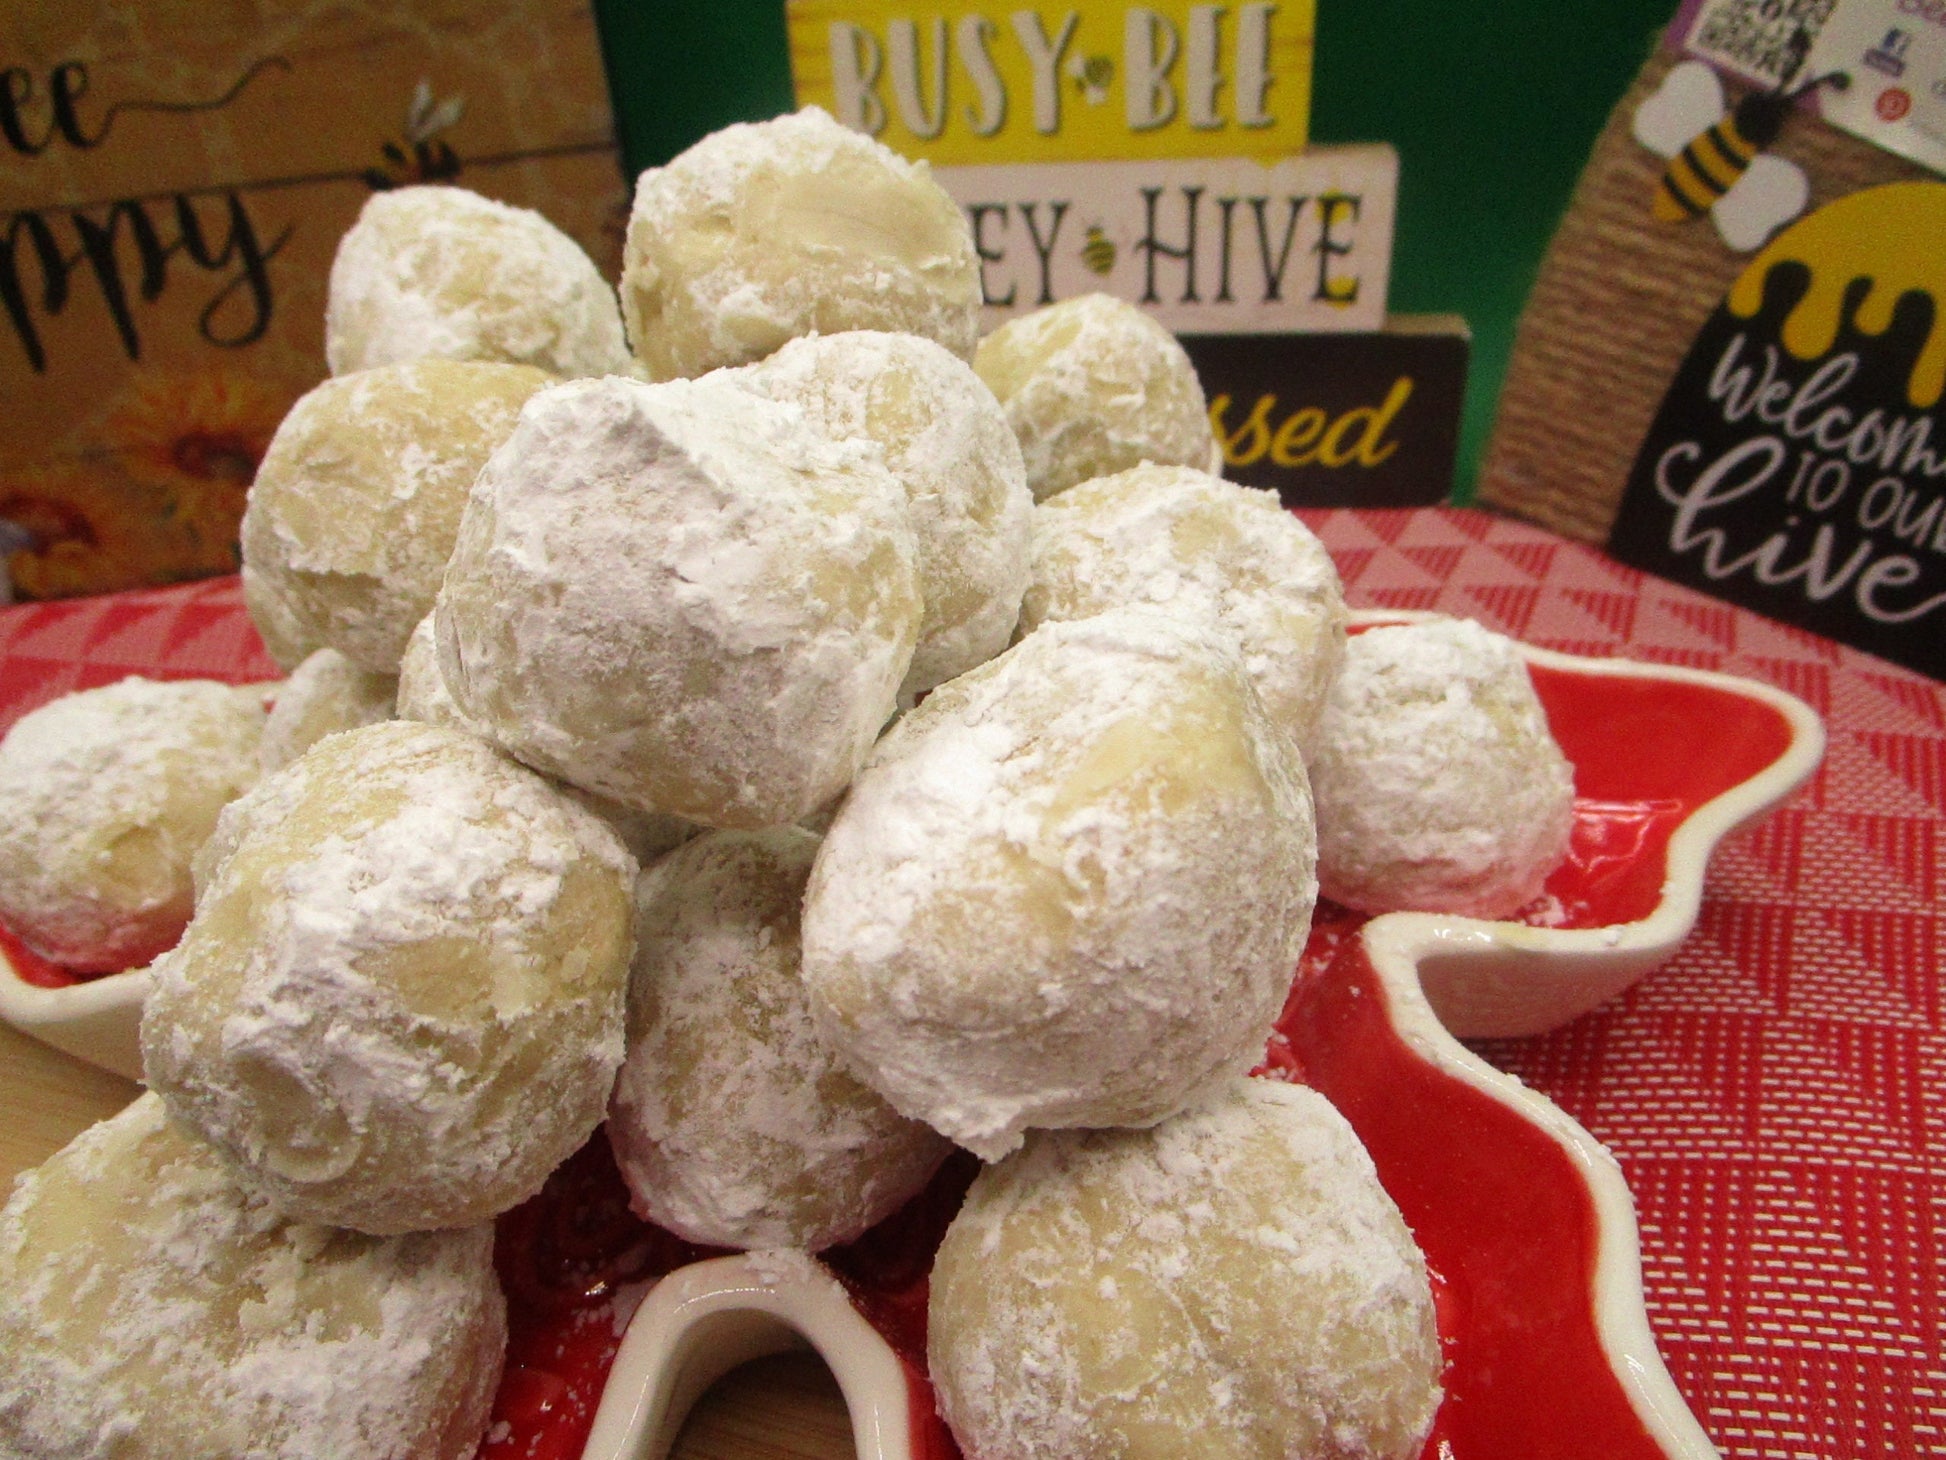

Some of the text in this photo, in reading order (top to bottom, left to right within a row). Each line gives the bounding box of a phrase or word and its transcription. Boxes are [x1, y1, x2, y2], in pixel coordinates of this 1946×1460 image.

[829, 3, 1277, 139] BUSY BEE
[1134, 186, 1364, 306] HIVE
[1656, 436, 1946, 623] hive
